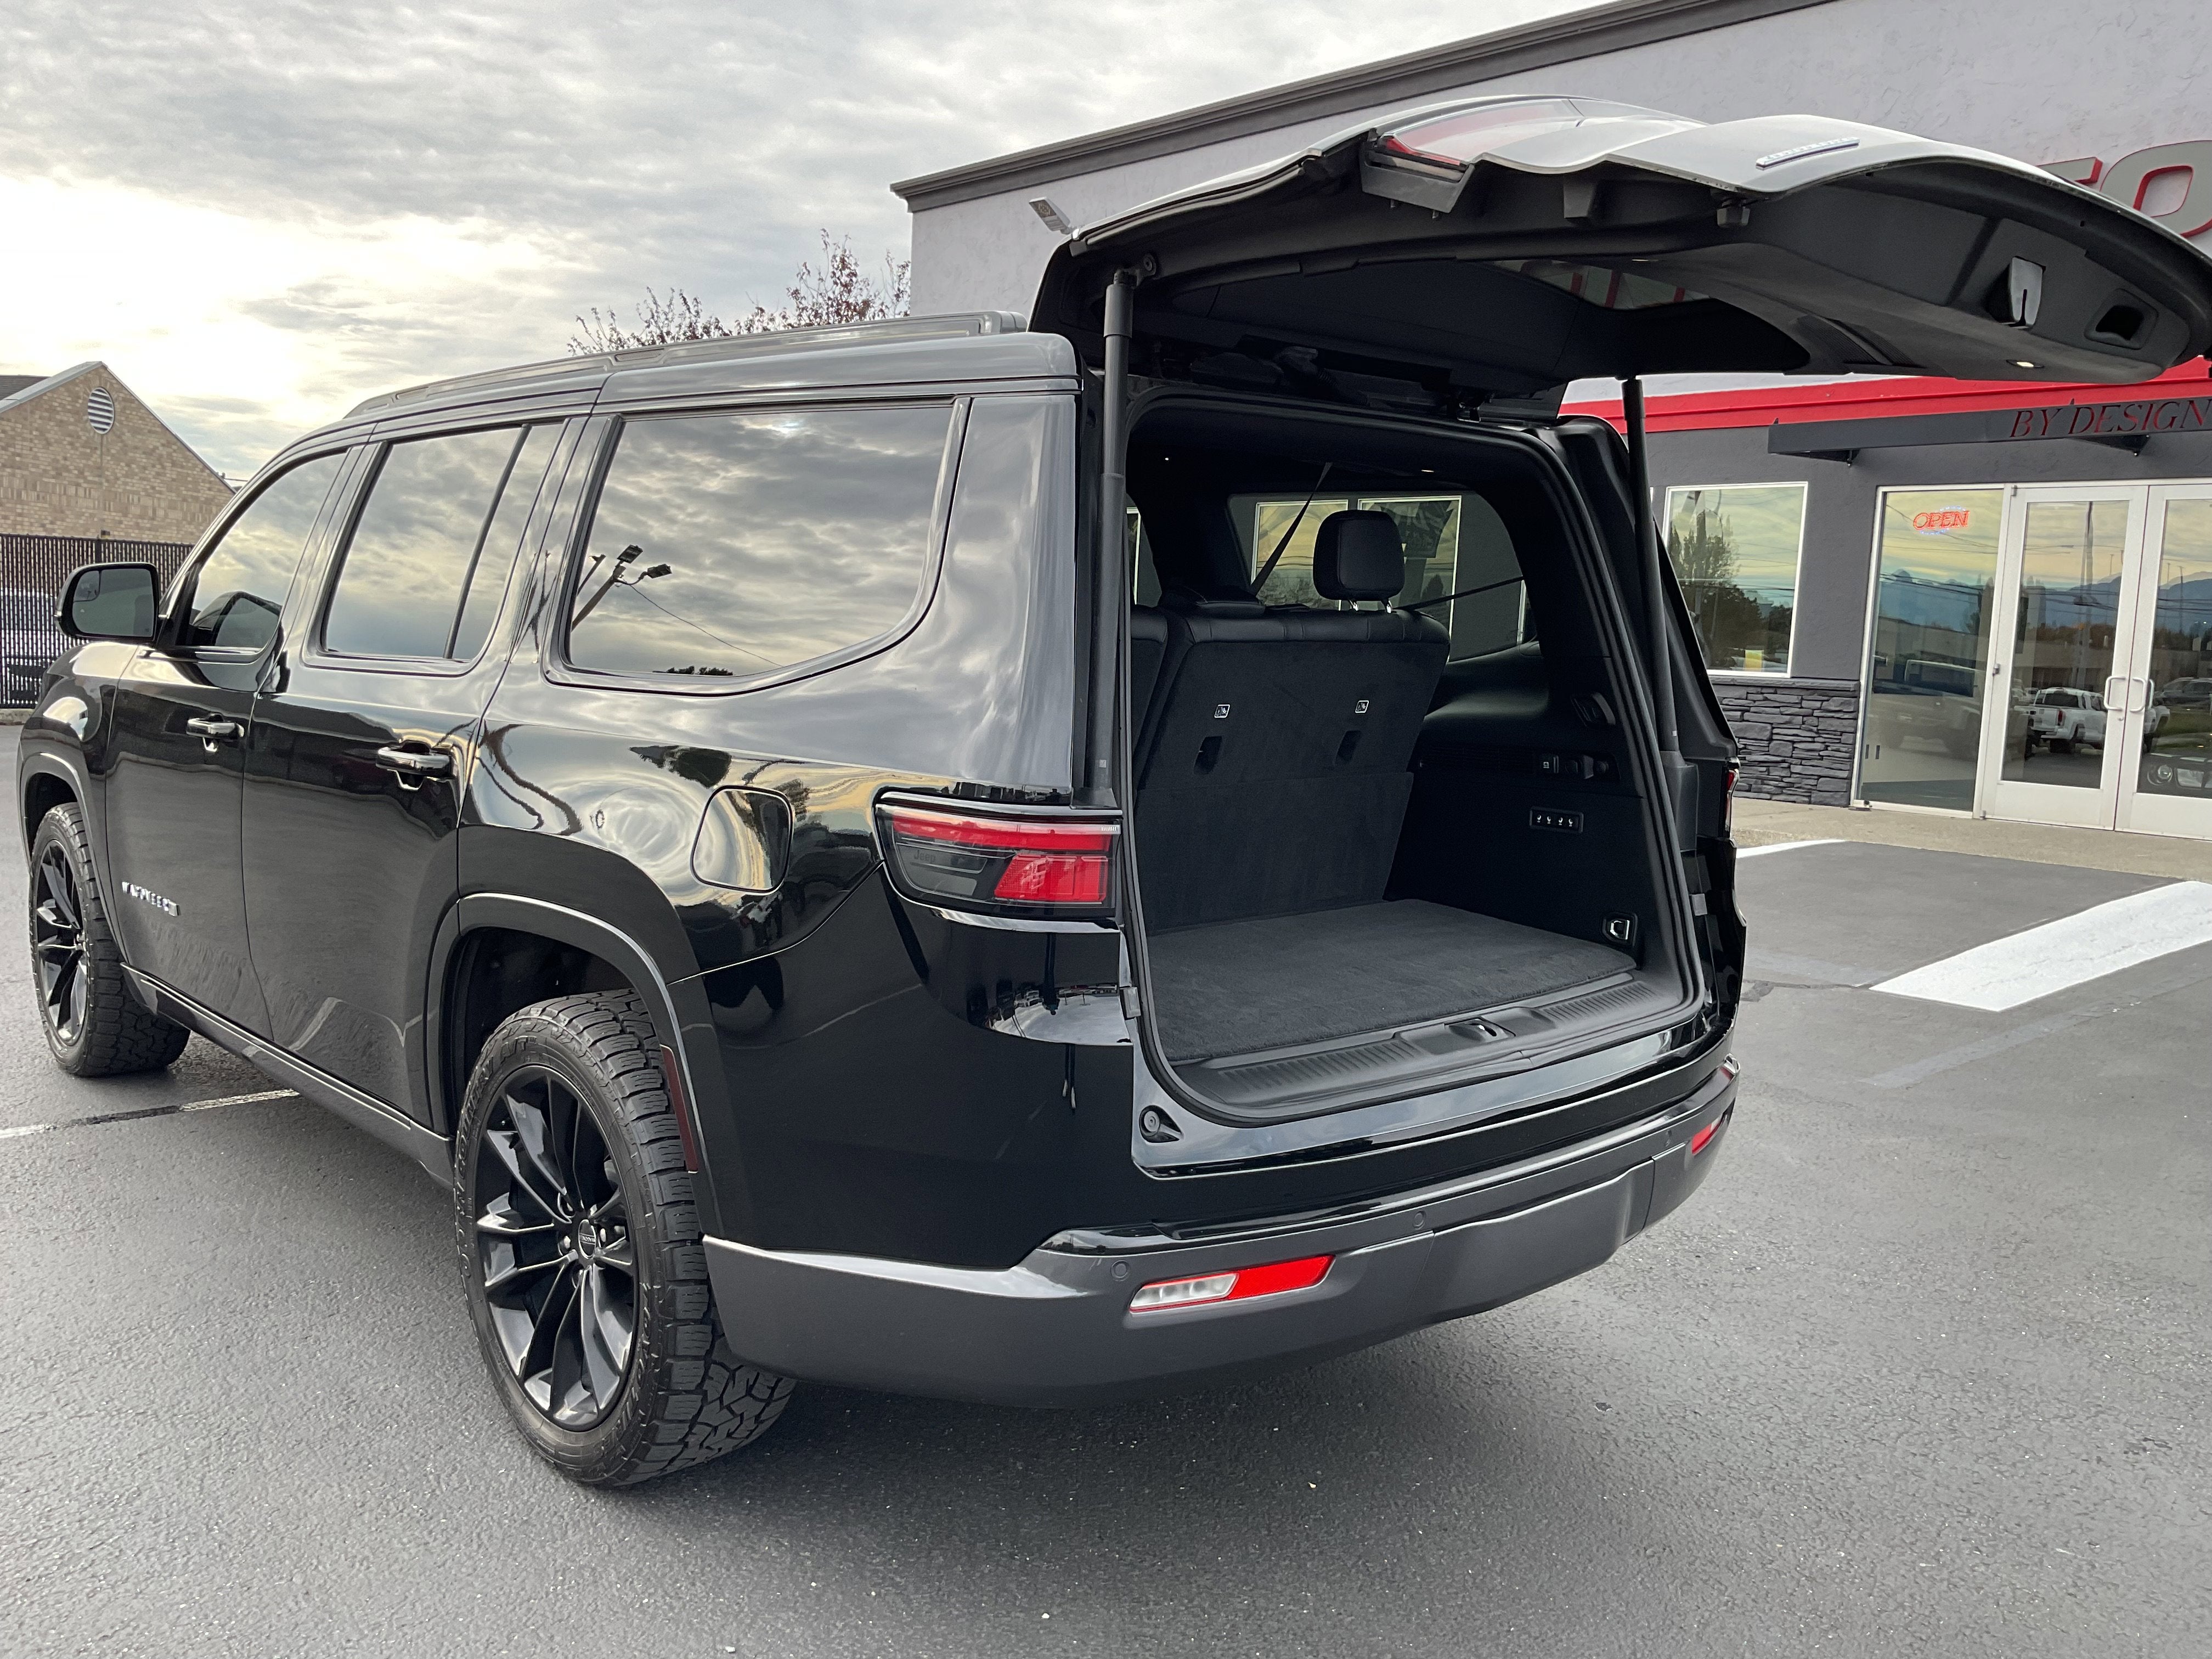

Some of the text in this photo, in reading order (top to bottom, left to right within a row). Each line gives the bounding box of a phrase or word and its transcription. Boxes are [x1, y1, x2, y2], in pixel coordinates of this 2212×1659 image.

[2010, 399, 2212, 438] BY DESIGN
[1913, 510, 1971, 531] OPEN
[913, 850, 937, 864] Jeep
